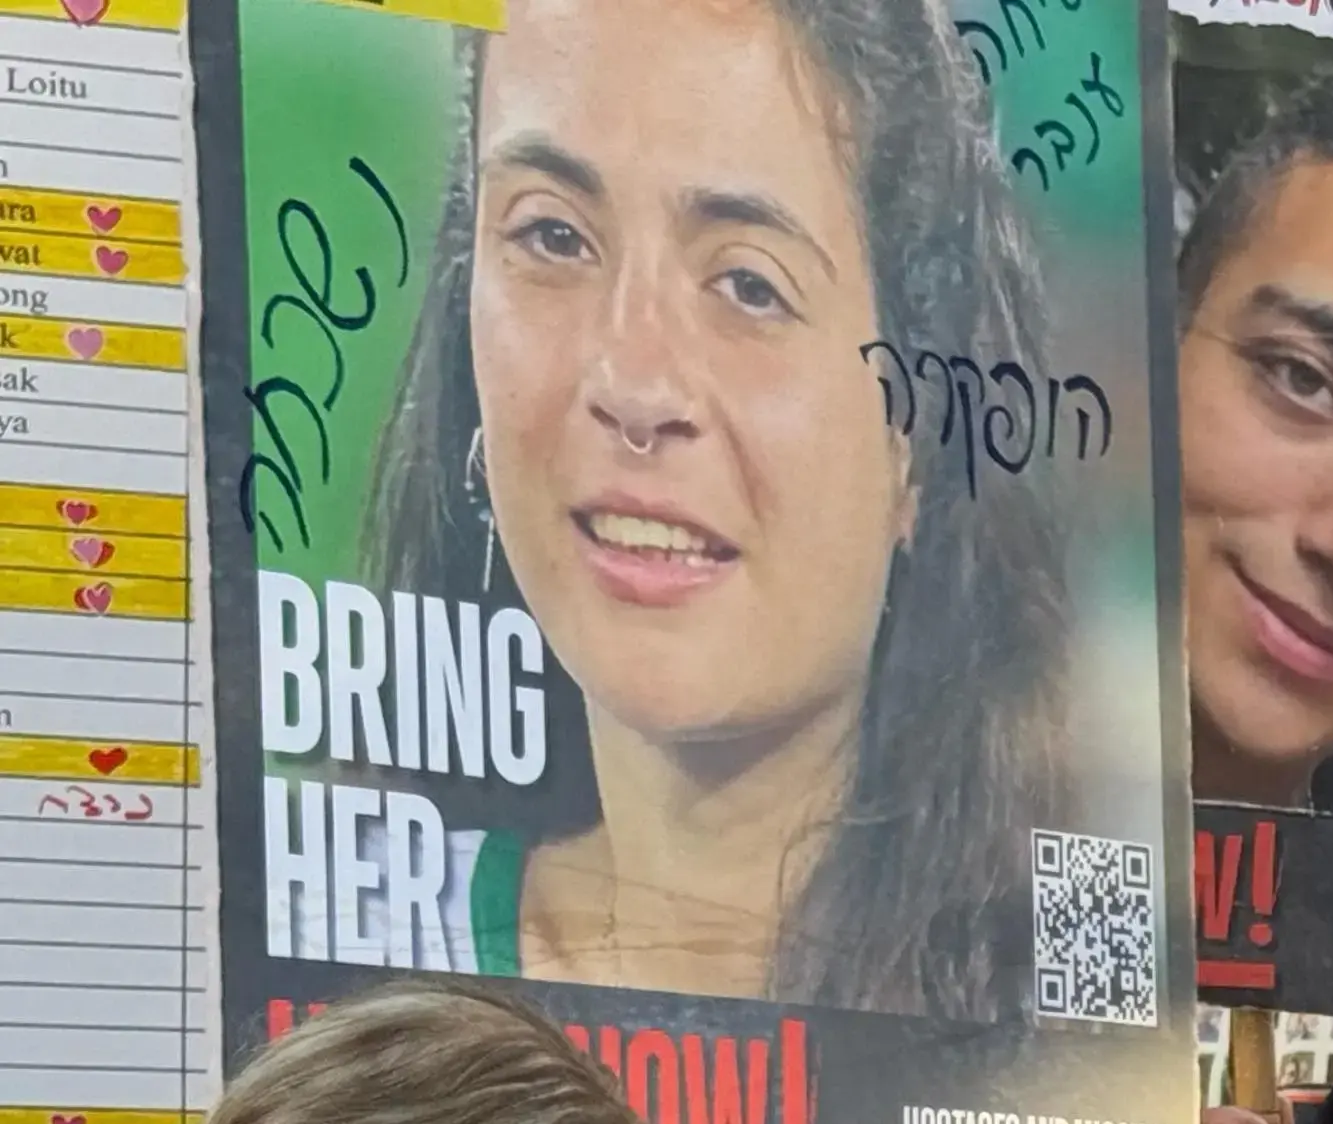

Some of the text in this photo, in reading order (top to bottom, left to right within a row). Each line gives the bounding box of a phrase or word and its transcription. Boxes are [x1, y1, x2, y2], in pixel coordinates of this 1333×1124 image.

[7, 67, 88, 99] Loitu
[257, 570, 547, 786] BRING
[264, 776, 453, 973] HER
